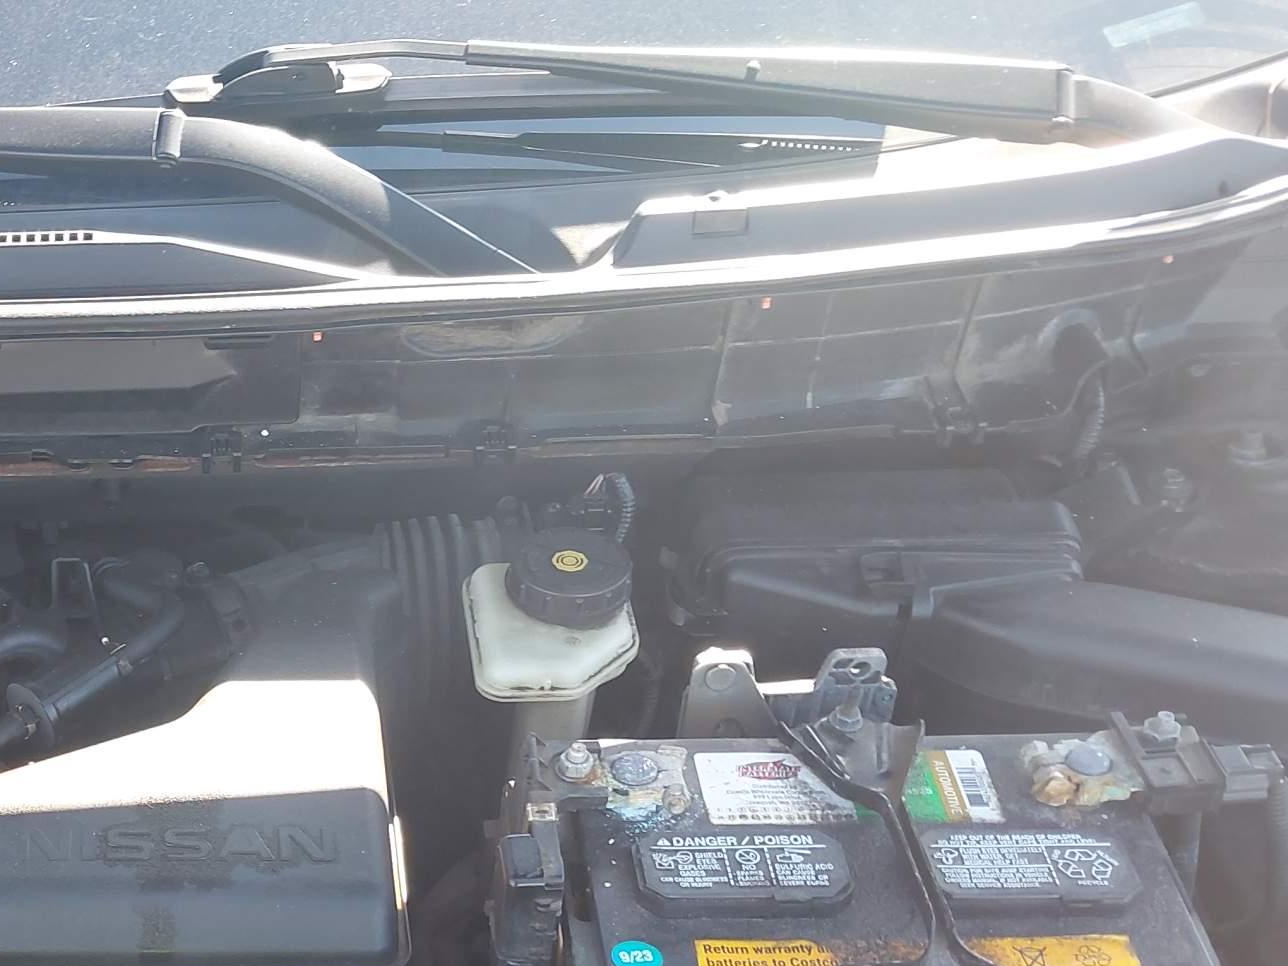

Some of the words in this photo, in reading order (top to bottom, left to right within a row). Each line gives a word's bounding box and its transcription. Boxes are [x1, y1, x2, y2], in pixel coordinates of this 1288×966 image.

[23, 823, 337, 863] NISSAN
[672, 836, 737, 846] DANGER
[753, 835, 813, 845] POISON
[618, 949, 654, 963] 9/23
[703, 944, 749, 954] Return
[752, 944, 812, 956] warranty
